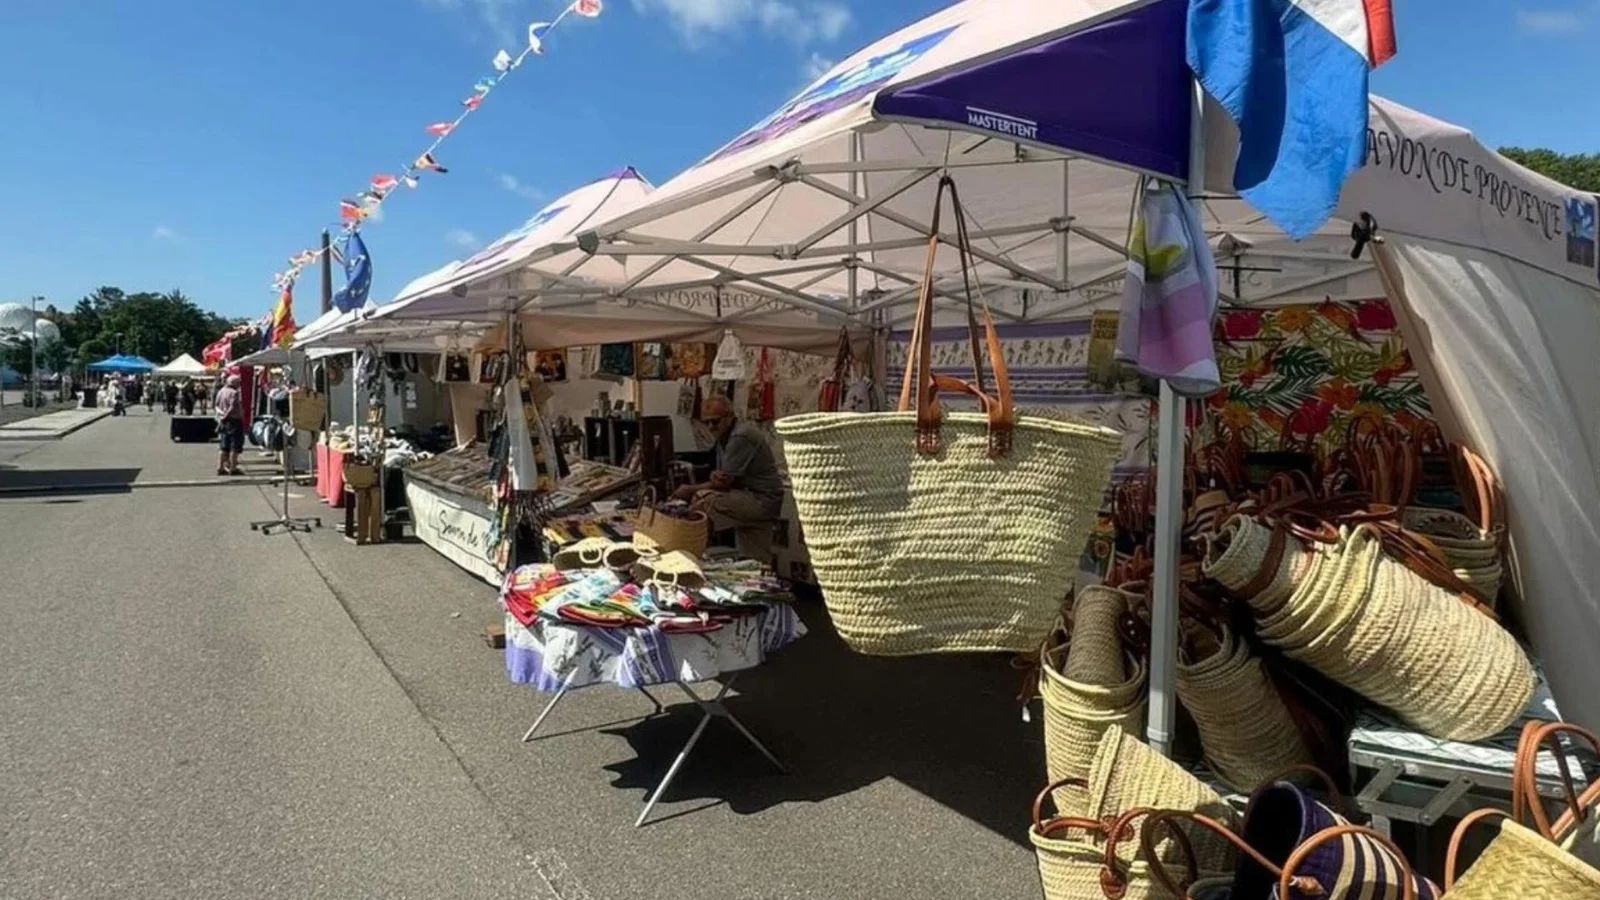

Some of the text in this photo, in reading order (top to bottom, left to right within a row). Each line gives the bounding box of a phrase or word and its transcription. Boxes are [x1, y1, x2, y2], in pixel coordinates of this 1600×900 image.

[967, 112, 1038, 139] MASTERTENT
[1366, 128, 1562, 240] AVON DE PROVENCE
